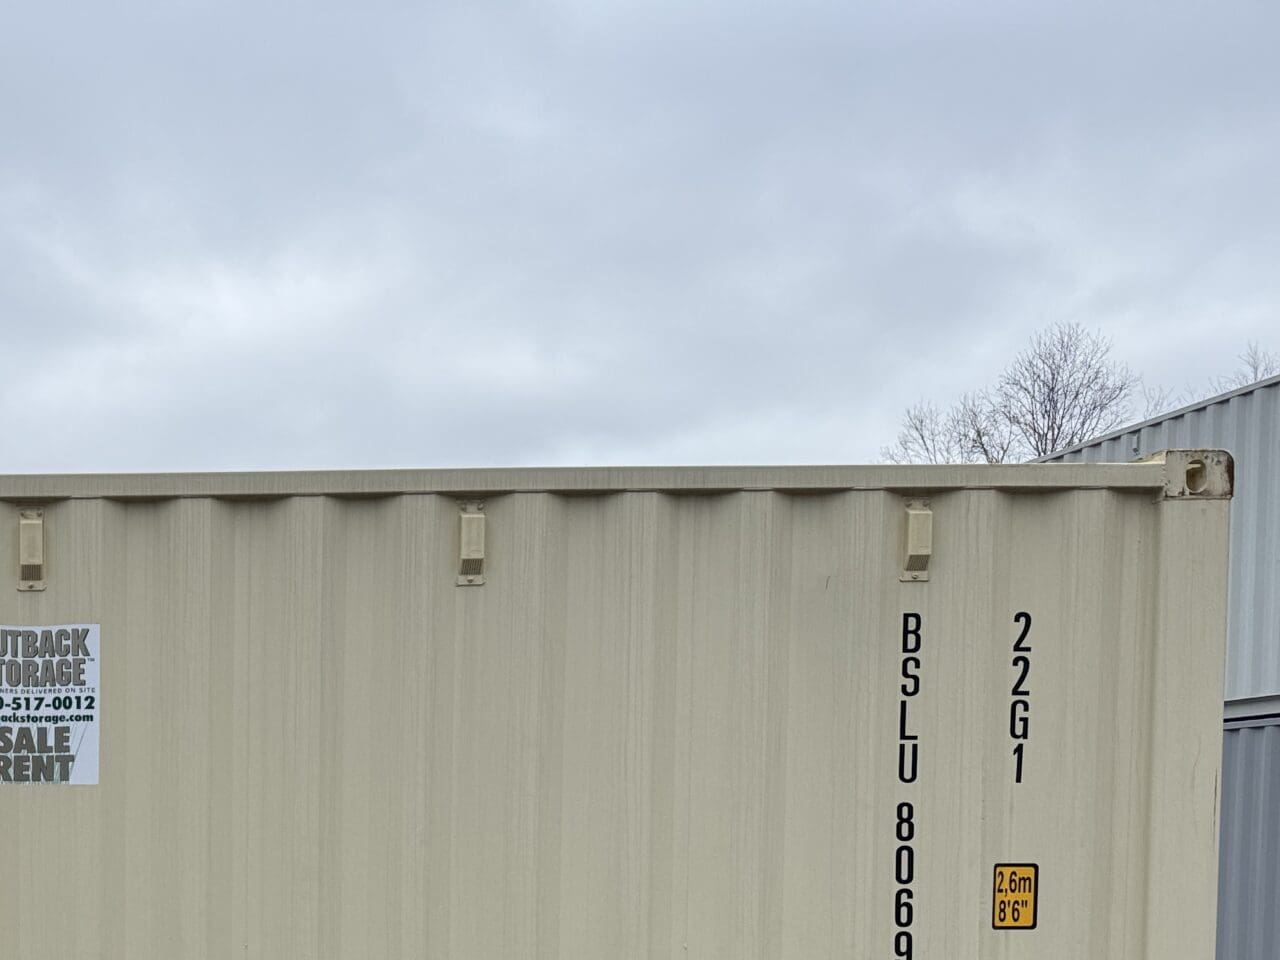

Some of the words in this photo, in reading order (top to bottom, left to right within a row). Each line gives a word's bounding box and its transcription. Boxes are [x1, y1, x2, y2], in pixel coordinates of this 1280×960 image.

[20, 687, 63, 695] DELIVERED
[898, 612, 922, 784] BSLU
[1009, 611, 1032, 784] 22G1
[996, 870, 1033, 897] 2,6m
[998, 900, 1029, 923] 8'6"
